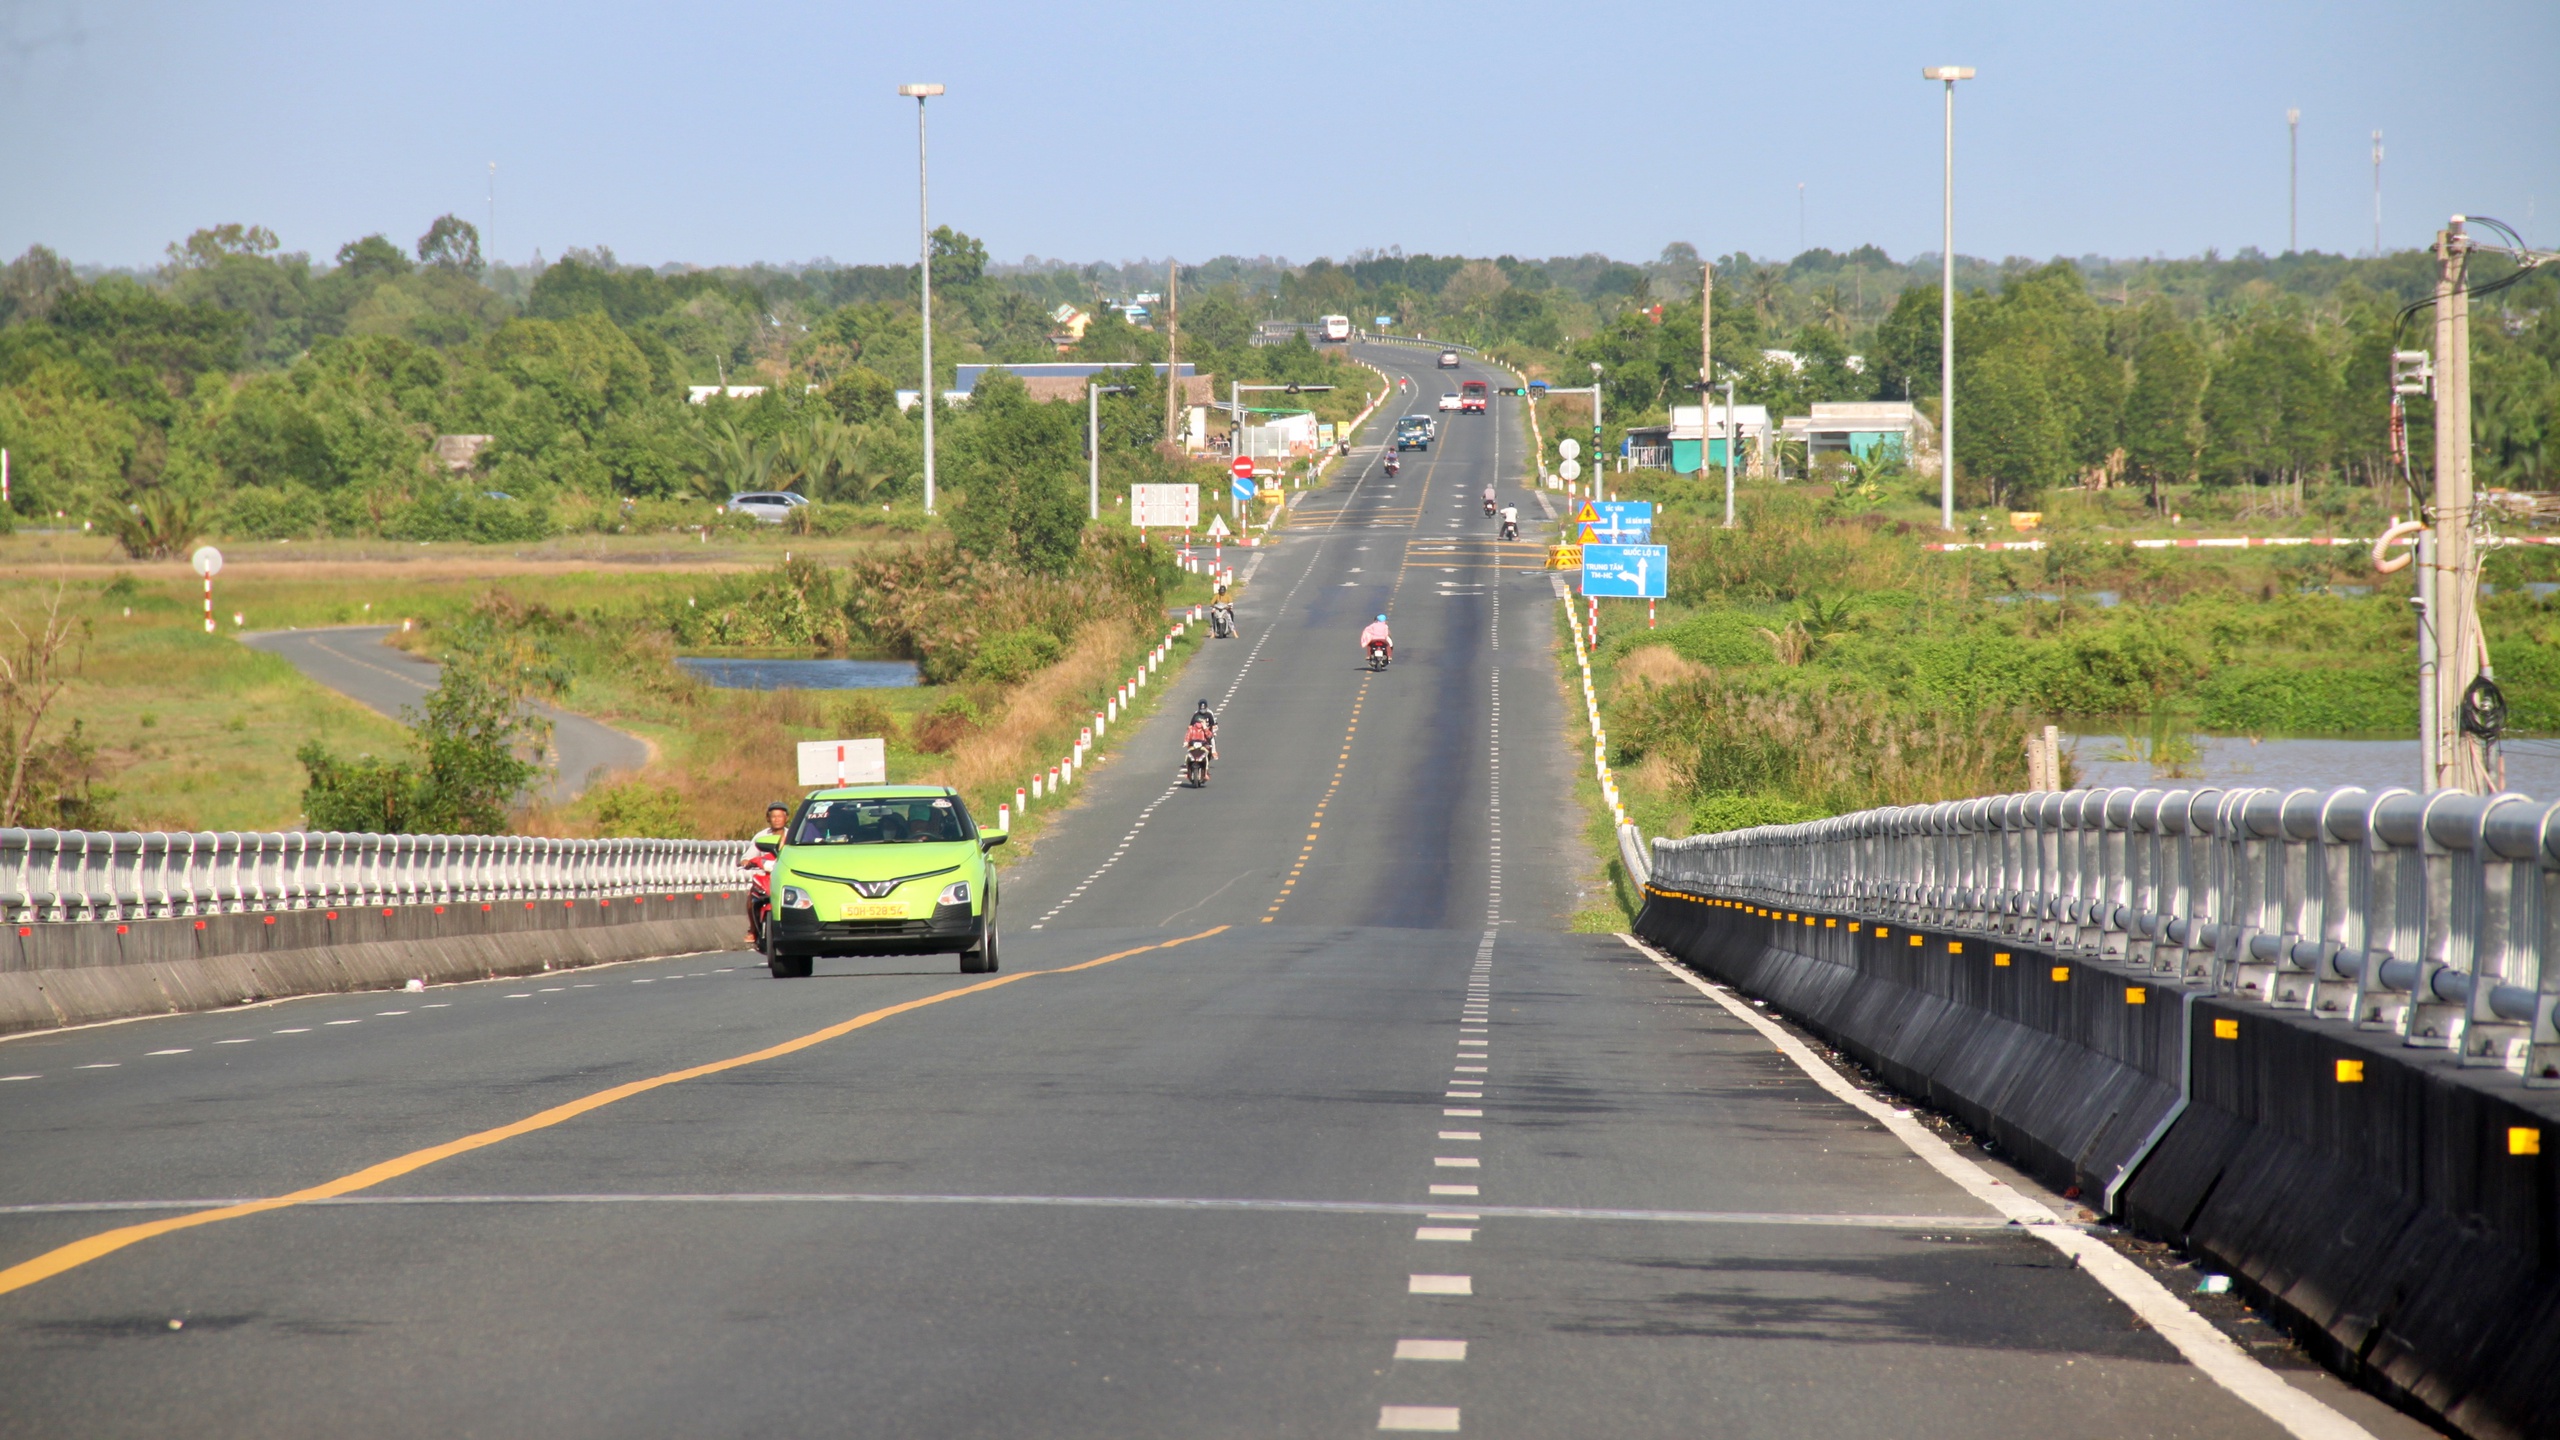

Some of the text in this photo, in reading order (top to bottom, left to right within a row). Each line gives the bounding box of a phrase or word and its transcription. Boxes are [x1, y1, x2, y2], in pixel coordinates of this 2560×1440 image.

[1623, 547, 1641, 556] QUỐC
[1643, 548, 1651, 557] LỘ
[1609, 562, 1623, 570] TÂM
